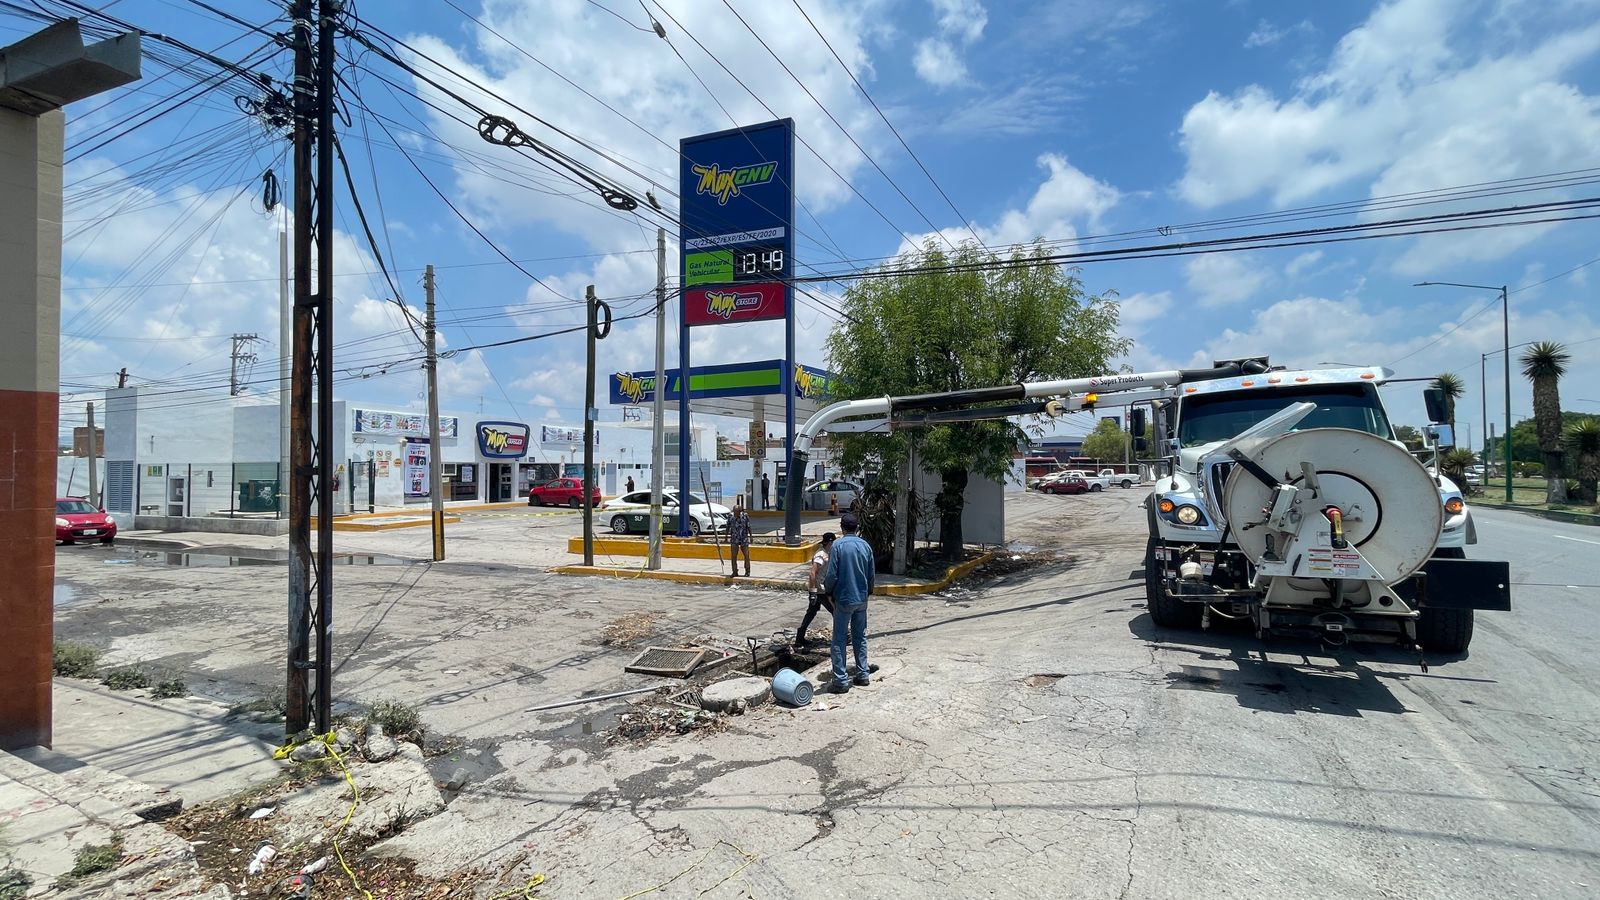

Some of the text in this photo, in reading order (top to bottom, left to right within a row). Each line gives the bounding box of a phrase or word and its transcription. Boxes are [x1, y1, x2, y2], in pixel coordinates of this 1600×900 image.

[736, 297, 758, 306] STORE
[1100, 375, 1145, 387] Super Products
